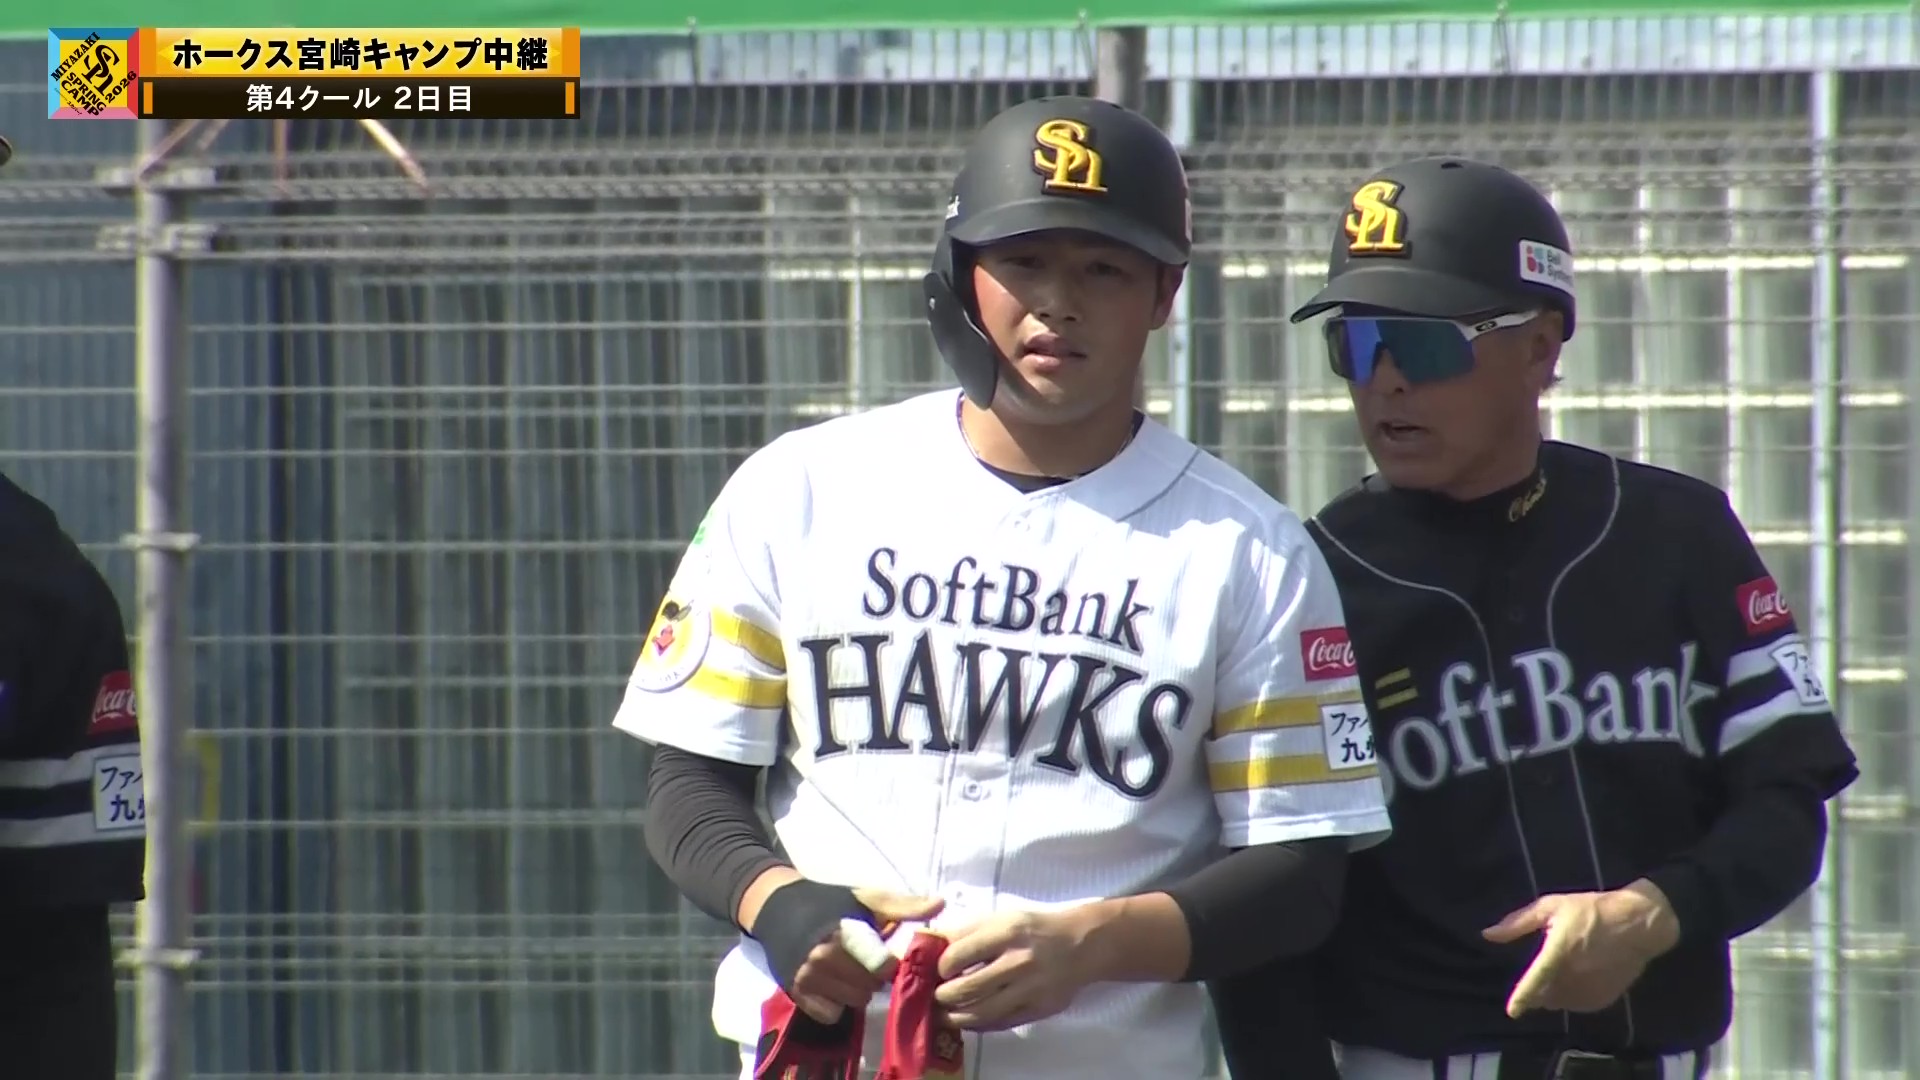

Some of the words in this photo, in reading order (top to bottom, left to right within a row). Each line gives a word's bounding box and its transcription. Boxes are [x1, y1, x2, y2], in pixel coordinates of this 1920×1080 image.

[861, 546, 1154, 656] SoftBank
[800, 627, 1193, 801] HAWKS
[1378, 638, 1722, 803] oftBank
